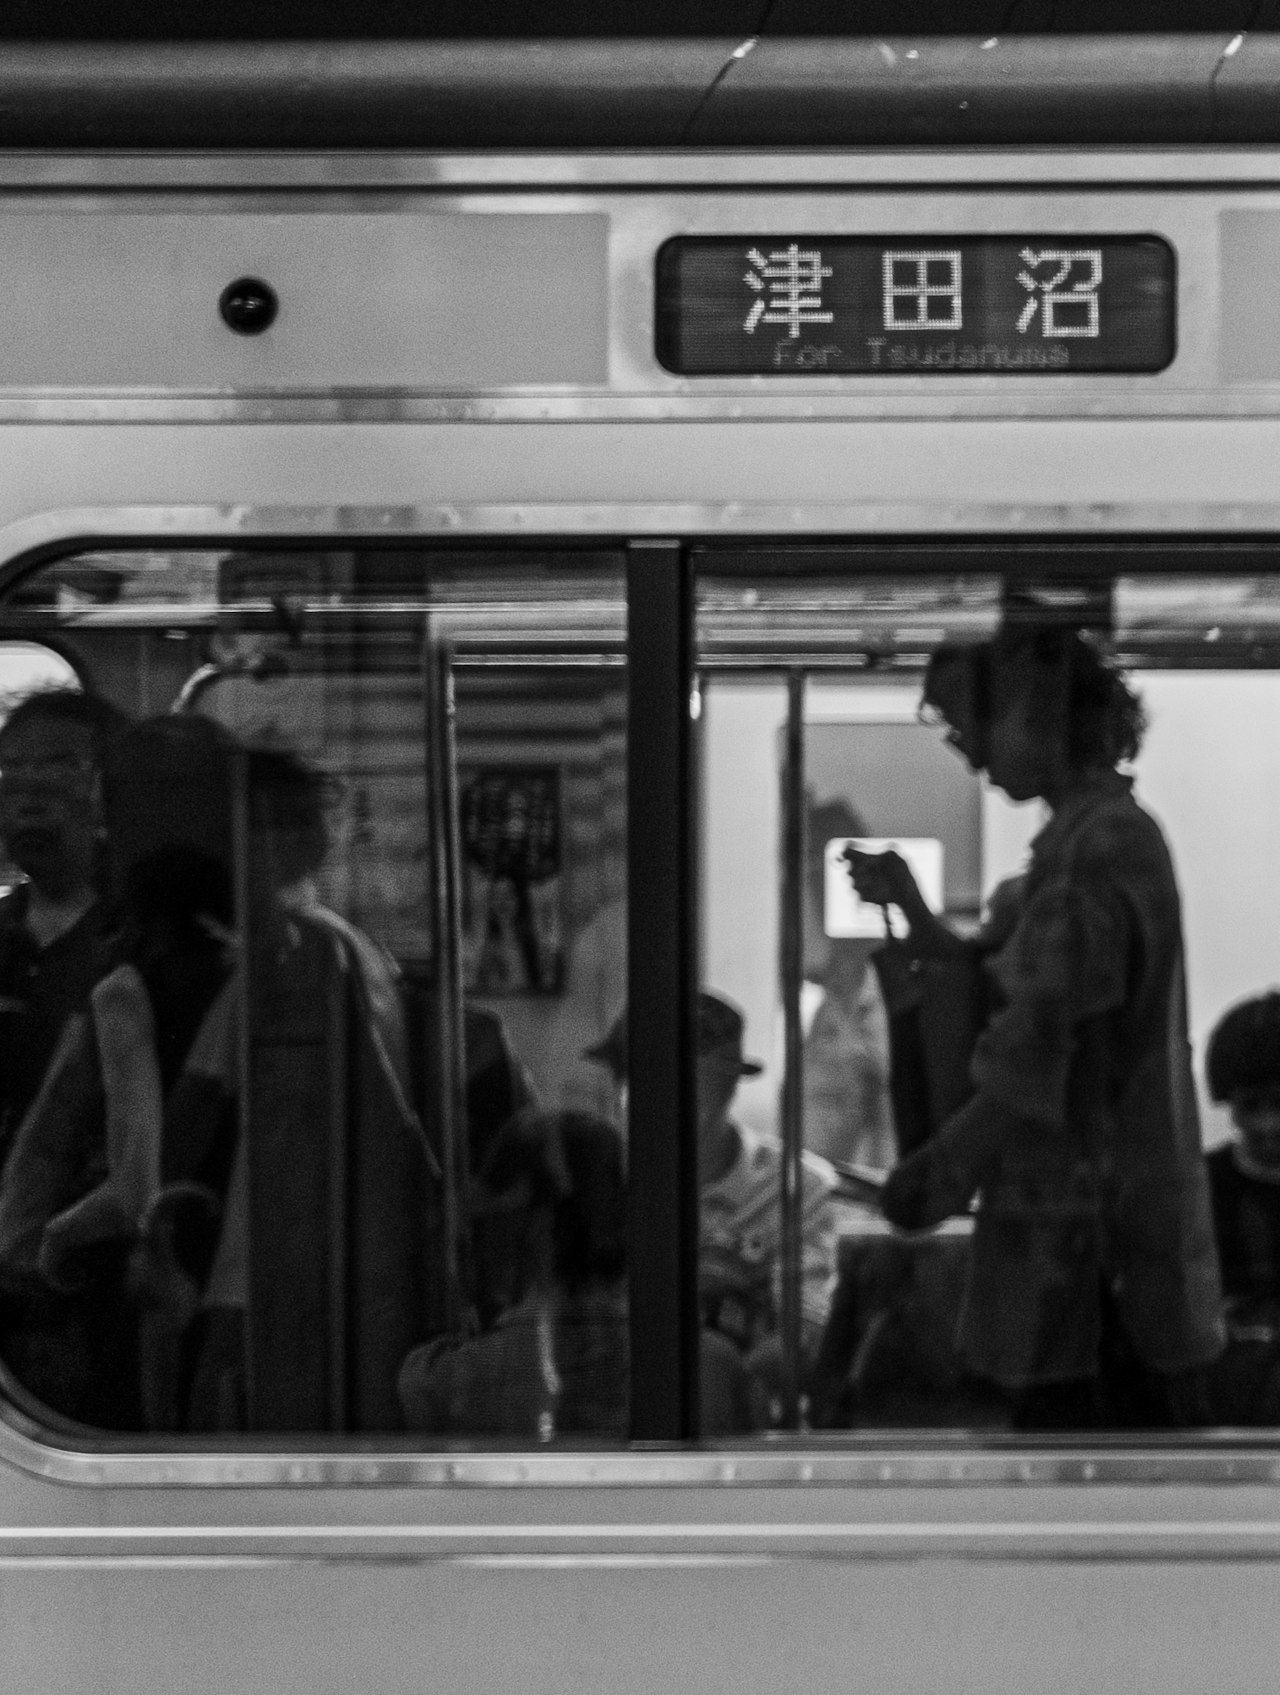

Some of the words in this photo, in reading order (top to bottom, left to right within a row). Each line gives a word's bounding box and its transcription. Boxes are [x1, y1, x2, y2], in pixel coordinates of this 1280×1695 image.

[742, 244, 1102, 338] 津田沼
[772, 339, 841, 367] For
[865, 336, 1071, 368] Tsudanuma
